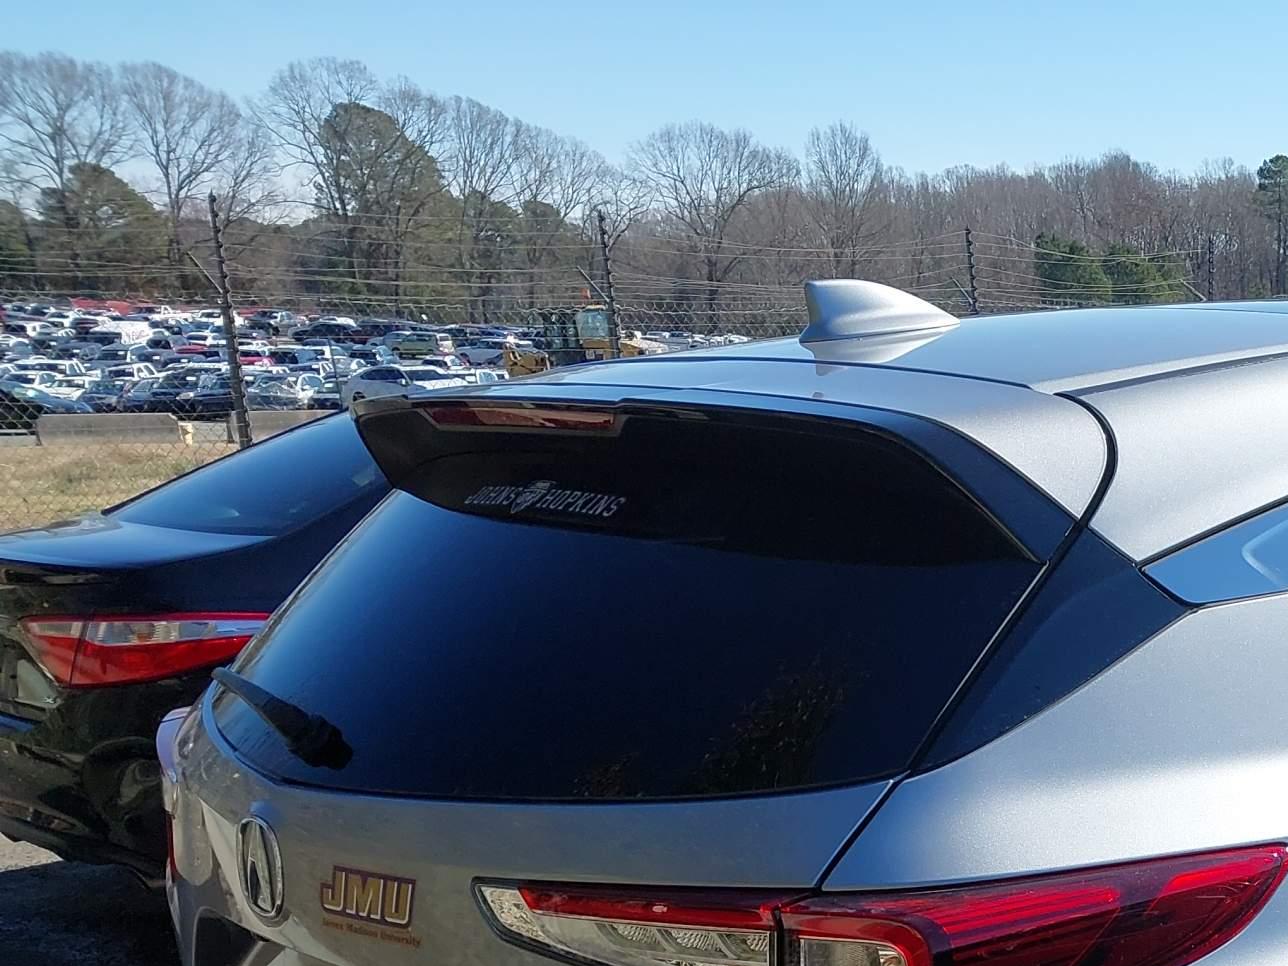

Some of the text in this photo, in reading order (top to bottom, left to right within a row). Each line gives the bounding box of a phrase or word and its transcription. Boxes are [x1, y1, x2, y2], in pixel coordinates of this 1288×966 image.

[464, 485, 626, 517] JOHNS HOPKINS
[321, 866, 415, 928] JMU
